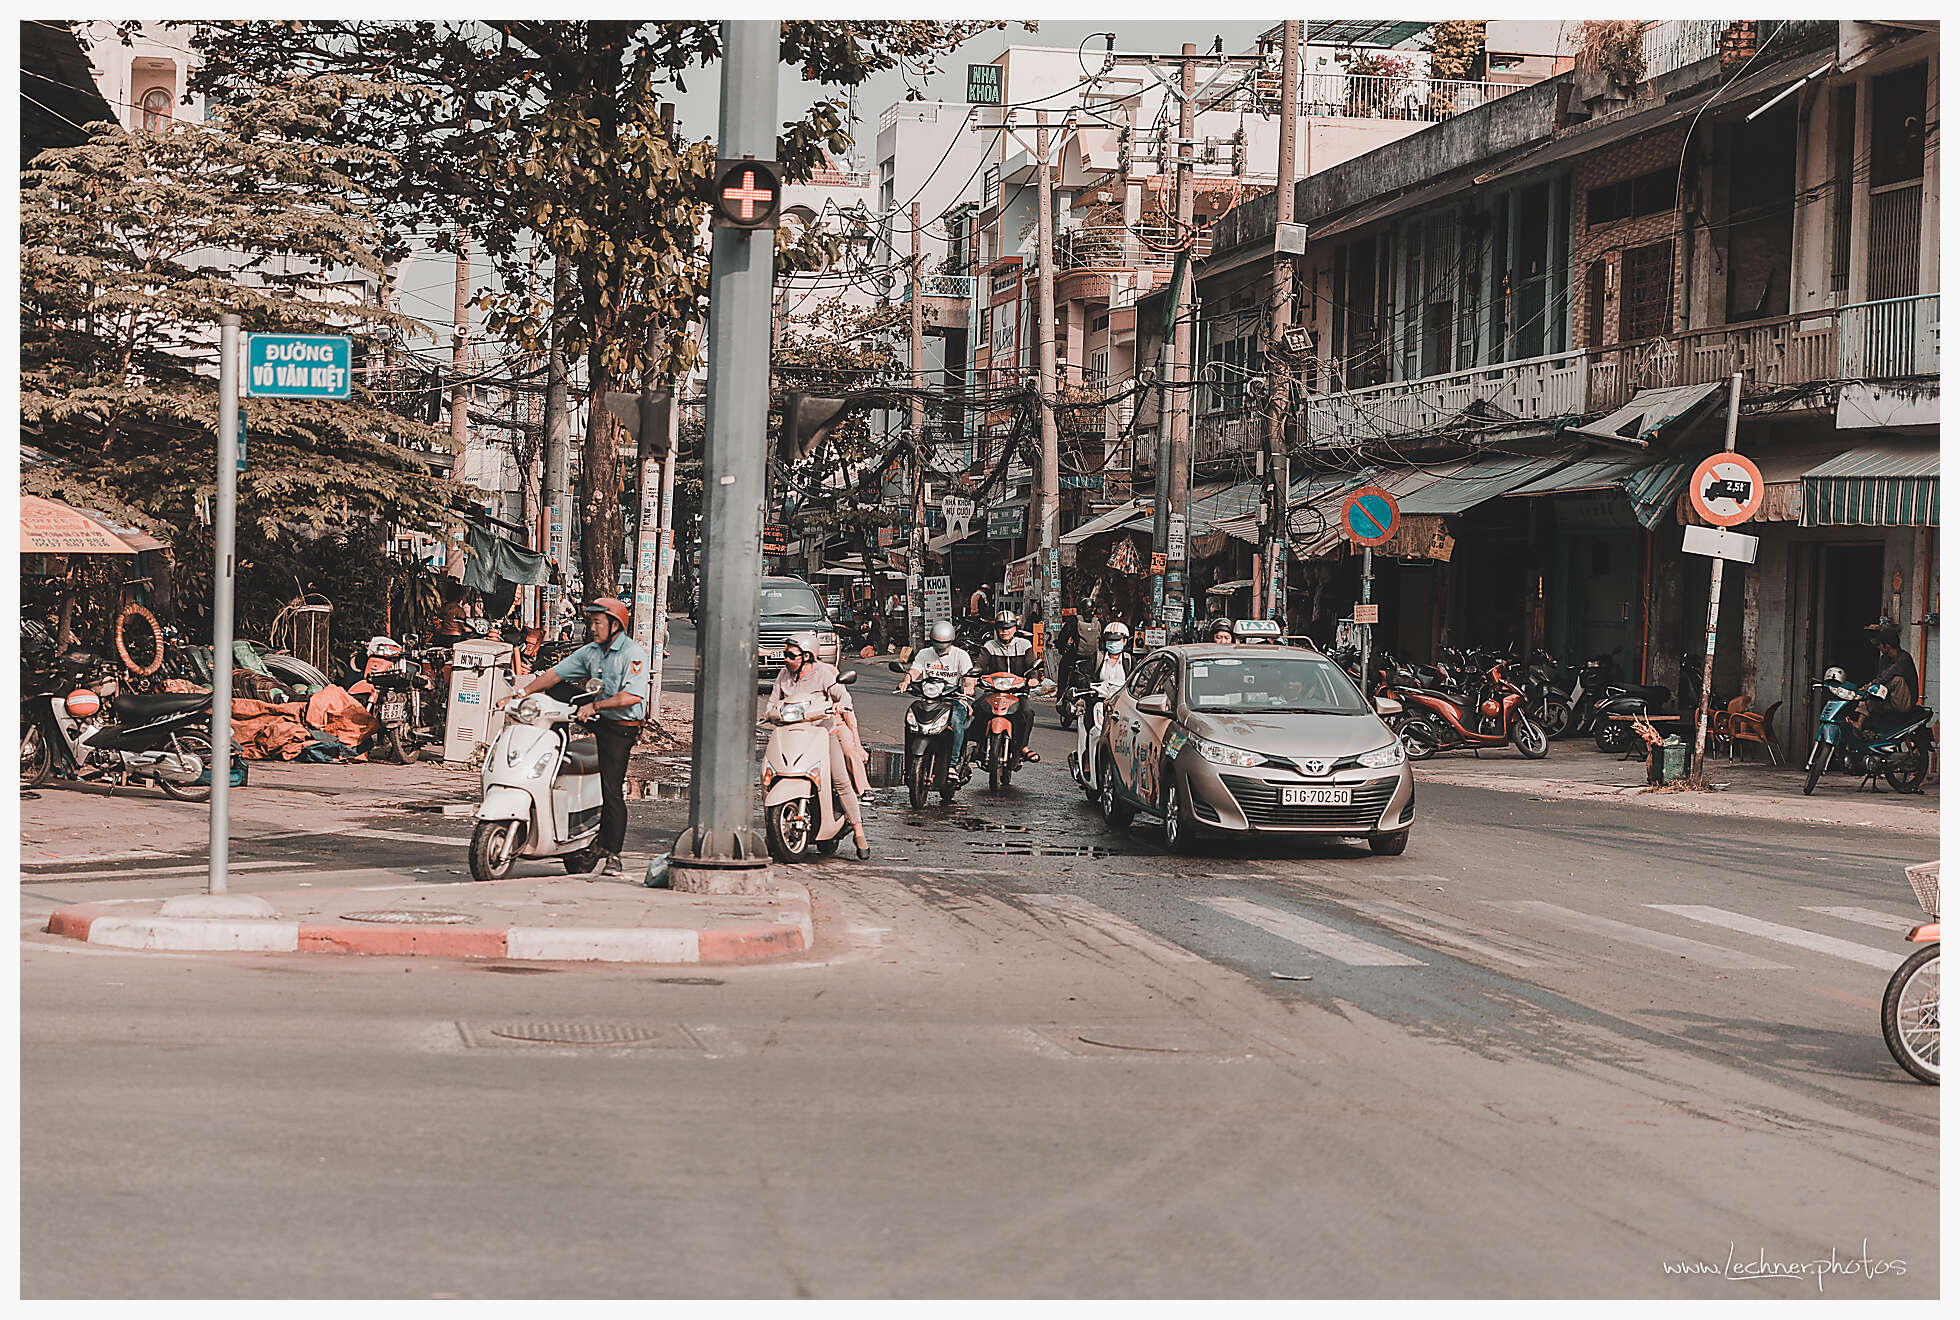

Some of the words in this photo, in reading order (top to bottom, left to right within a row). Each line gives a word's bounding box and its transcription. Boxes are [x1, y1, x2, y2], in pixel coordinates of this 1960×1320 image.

[973, 66, 997, 84] NHA
[969, 84, 1000, 102] KHOA
[265, 341, 334, 361] ĐƯỜNG
[253, 362, 274, 387] VÕ
[276, 363, 309, 388] VĂN
[311, 364, 345, 392] KIỆT
[926, 579, 947, 590] KHOA
[1285, 789, 1348, 803] 51G-702.50
